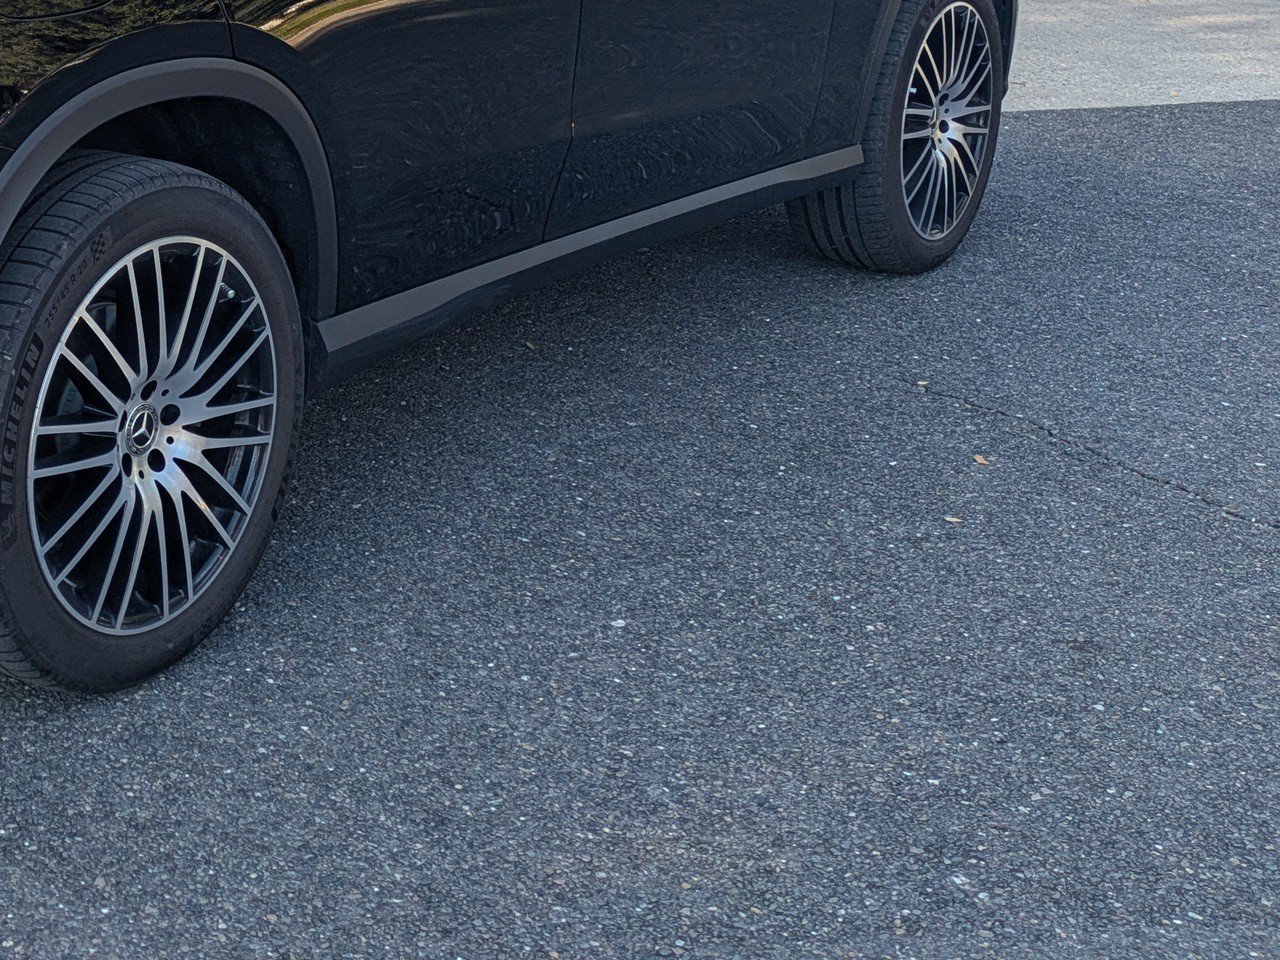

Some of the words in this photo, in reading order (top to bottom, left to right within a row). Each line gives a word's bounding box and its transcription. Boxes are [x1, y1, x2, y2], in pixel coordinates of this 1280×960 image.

[70, 274, 77, 284] R
[77, 259, 88, 275] 20
[1, 340, 42, 505] MICHELIN
